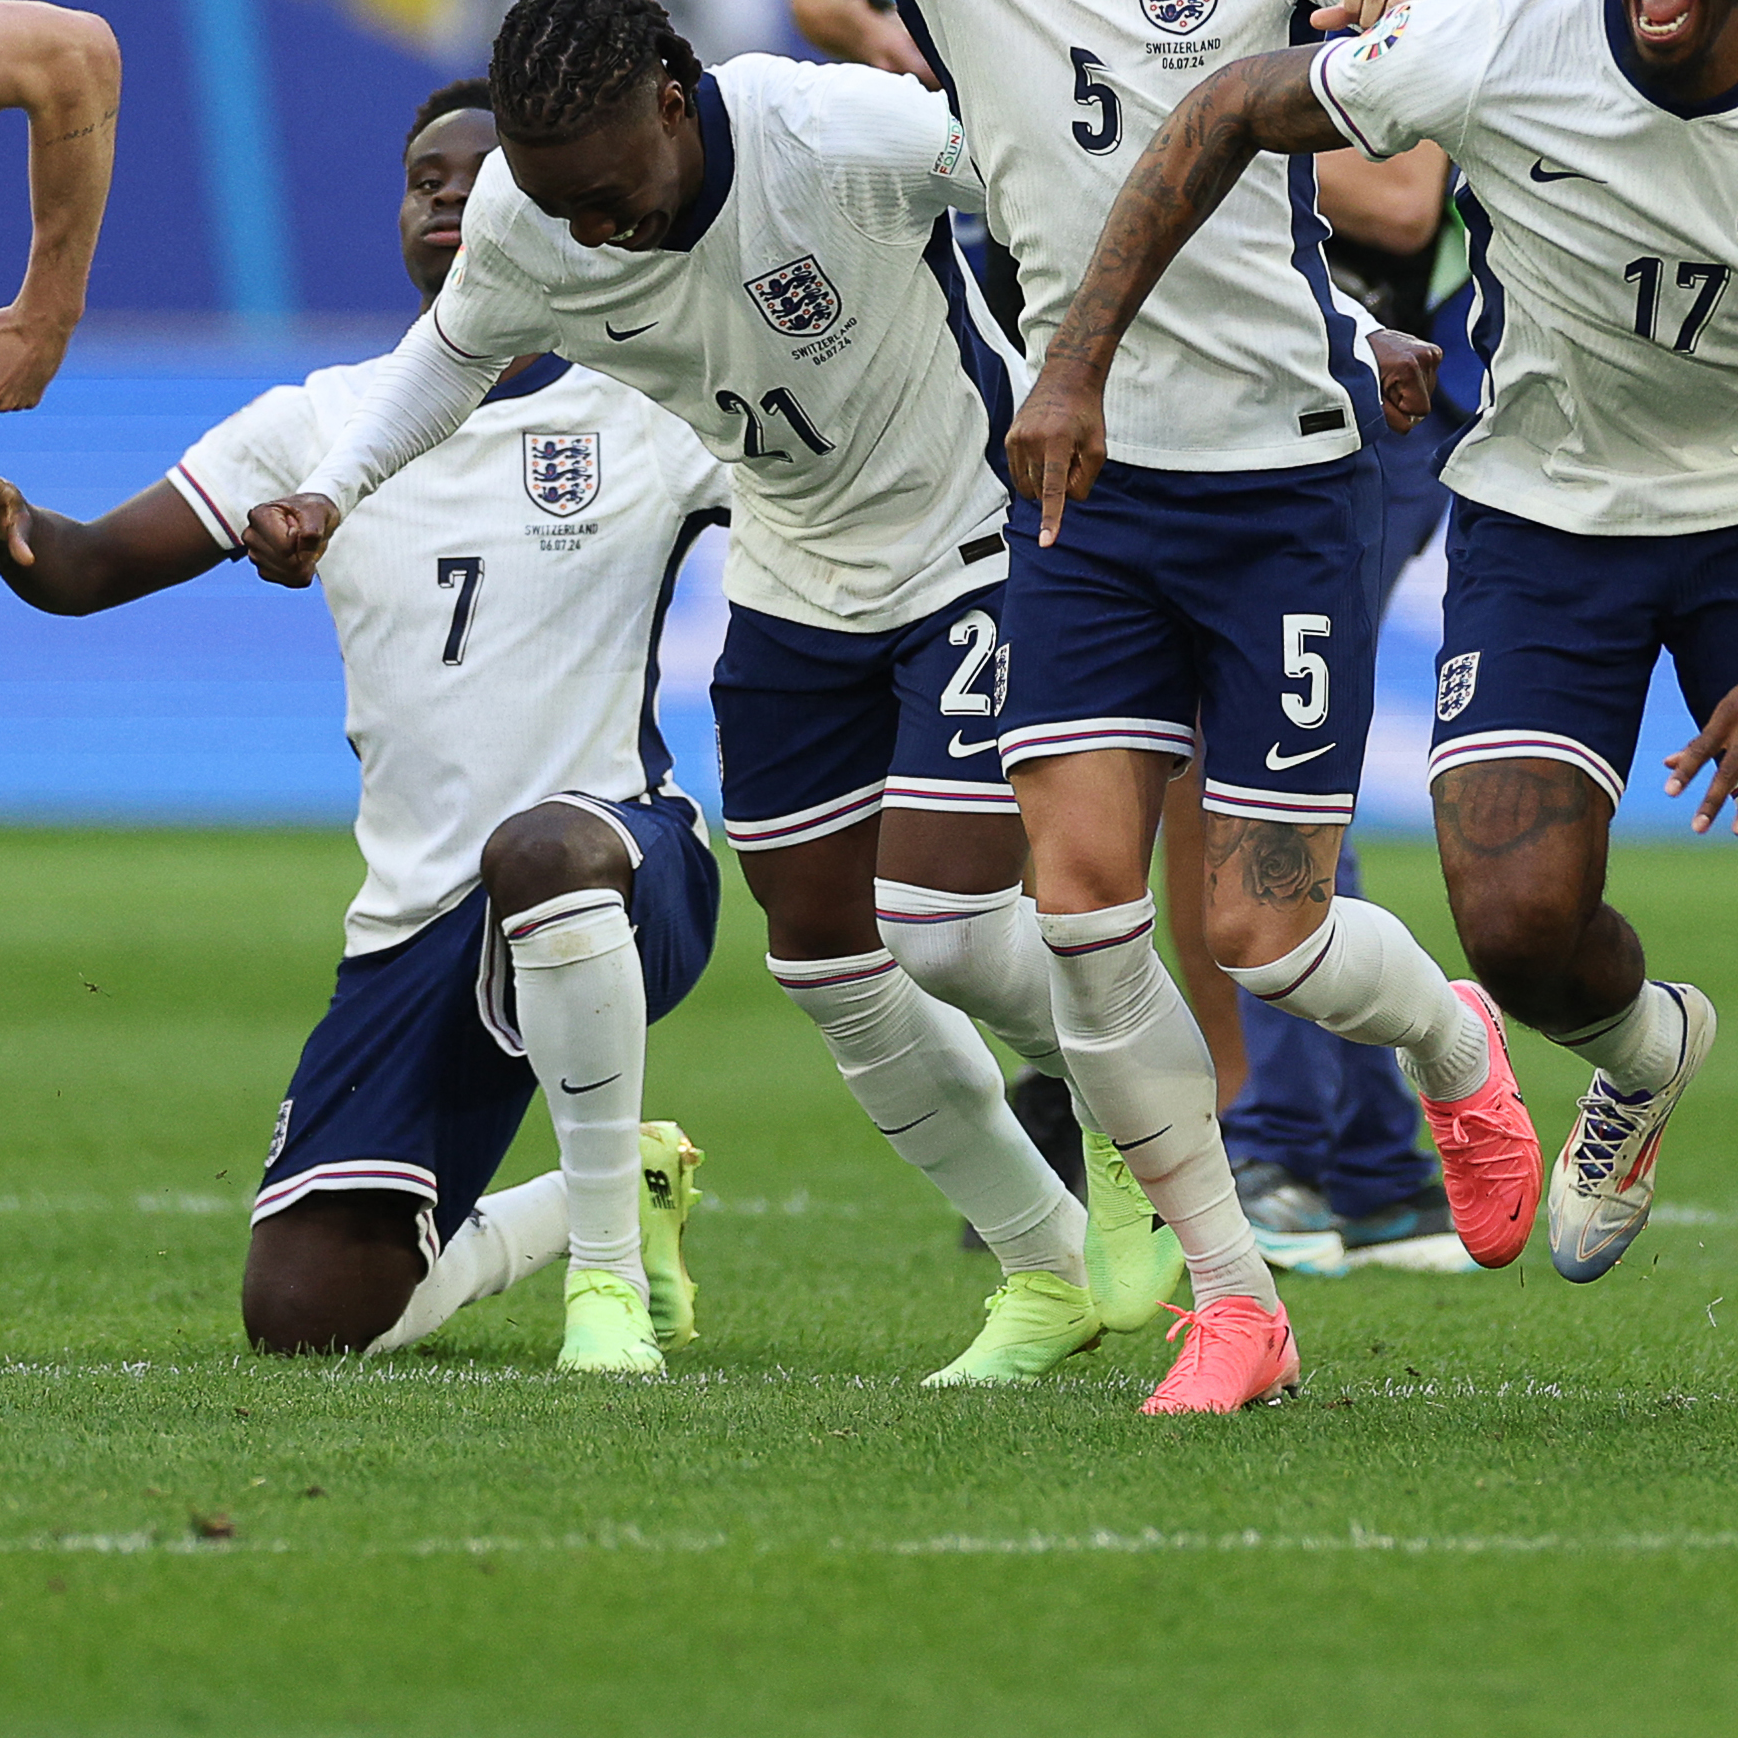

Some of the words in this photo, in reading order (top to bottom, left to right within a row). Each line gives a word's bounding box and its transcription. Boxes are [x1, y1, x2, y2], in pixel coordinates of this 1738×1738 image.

[1146, 38, 1221, 54] SWITZERLAND
[1162, 56, 1204, 70] 06.07.24
[1072, 48, 1122, 155] 5
[939, 118, 961, 175] FOUND
[1624, 257, 1731, 353] 17
[791, 317, 857, 360] SWITZERLAND
[812, 337, 852, 366] 06.07.24
[715, 386, 837, 462] 21
[525, 523, 599, 536] SWITZERLAND
[436, 556, 485, 666] 7
[940, 610, 998, 717] 2
[1281, 613, 1331, 729] 5
